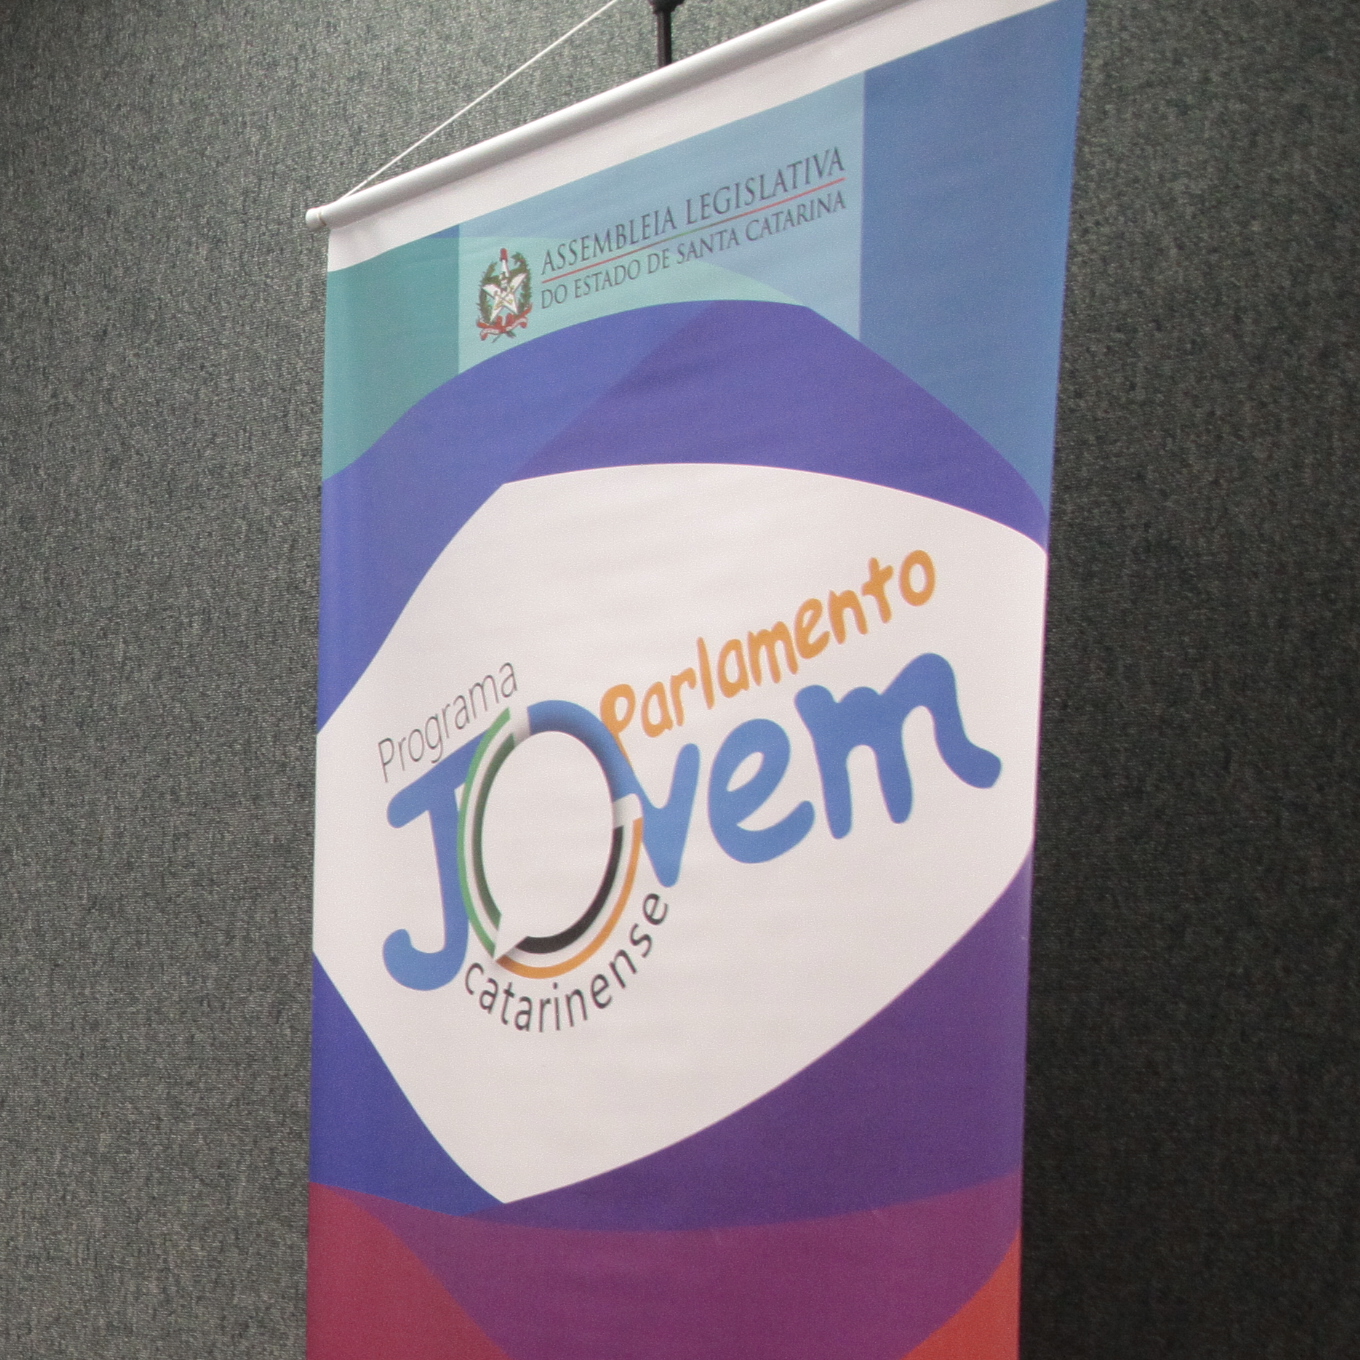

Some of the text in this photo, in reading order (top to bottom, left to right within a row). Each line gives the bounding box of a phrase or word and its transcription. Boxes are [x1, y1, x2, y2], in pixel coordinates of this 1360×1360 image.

[541, 147, 845, 275] ASSEMBLEIA LEGISLATIVA
[541, 190, 846, 309] DO ESTADO DE SANTA CATARINA
[600, 550, 936, 755] Parlamento
[378, 661, 518, 783] Programa
